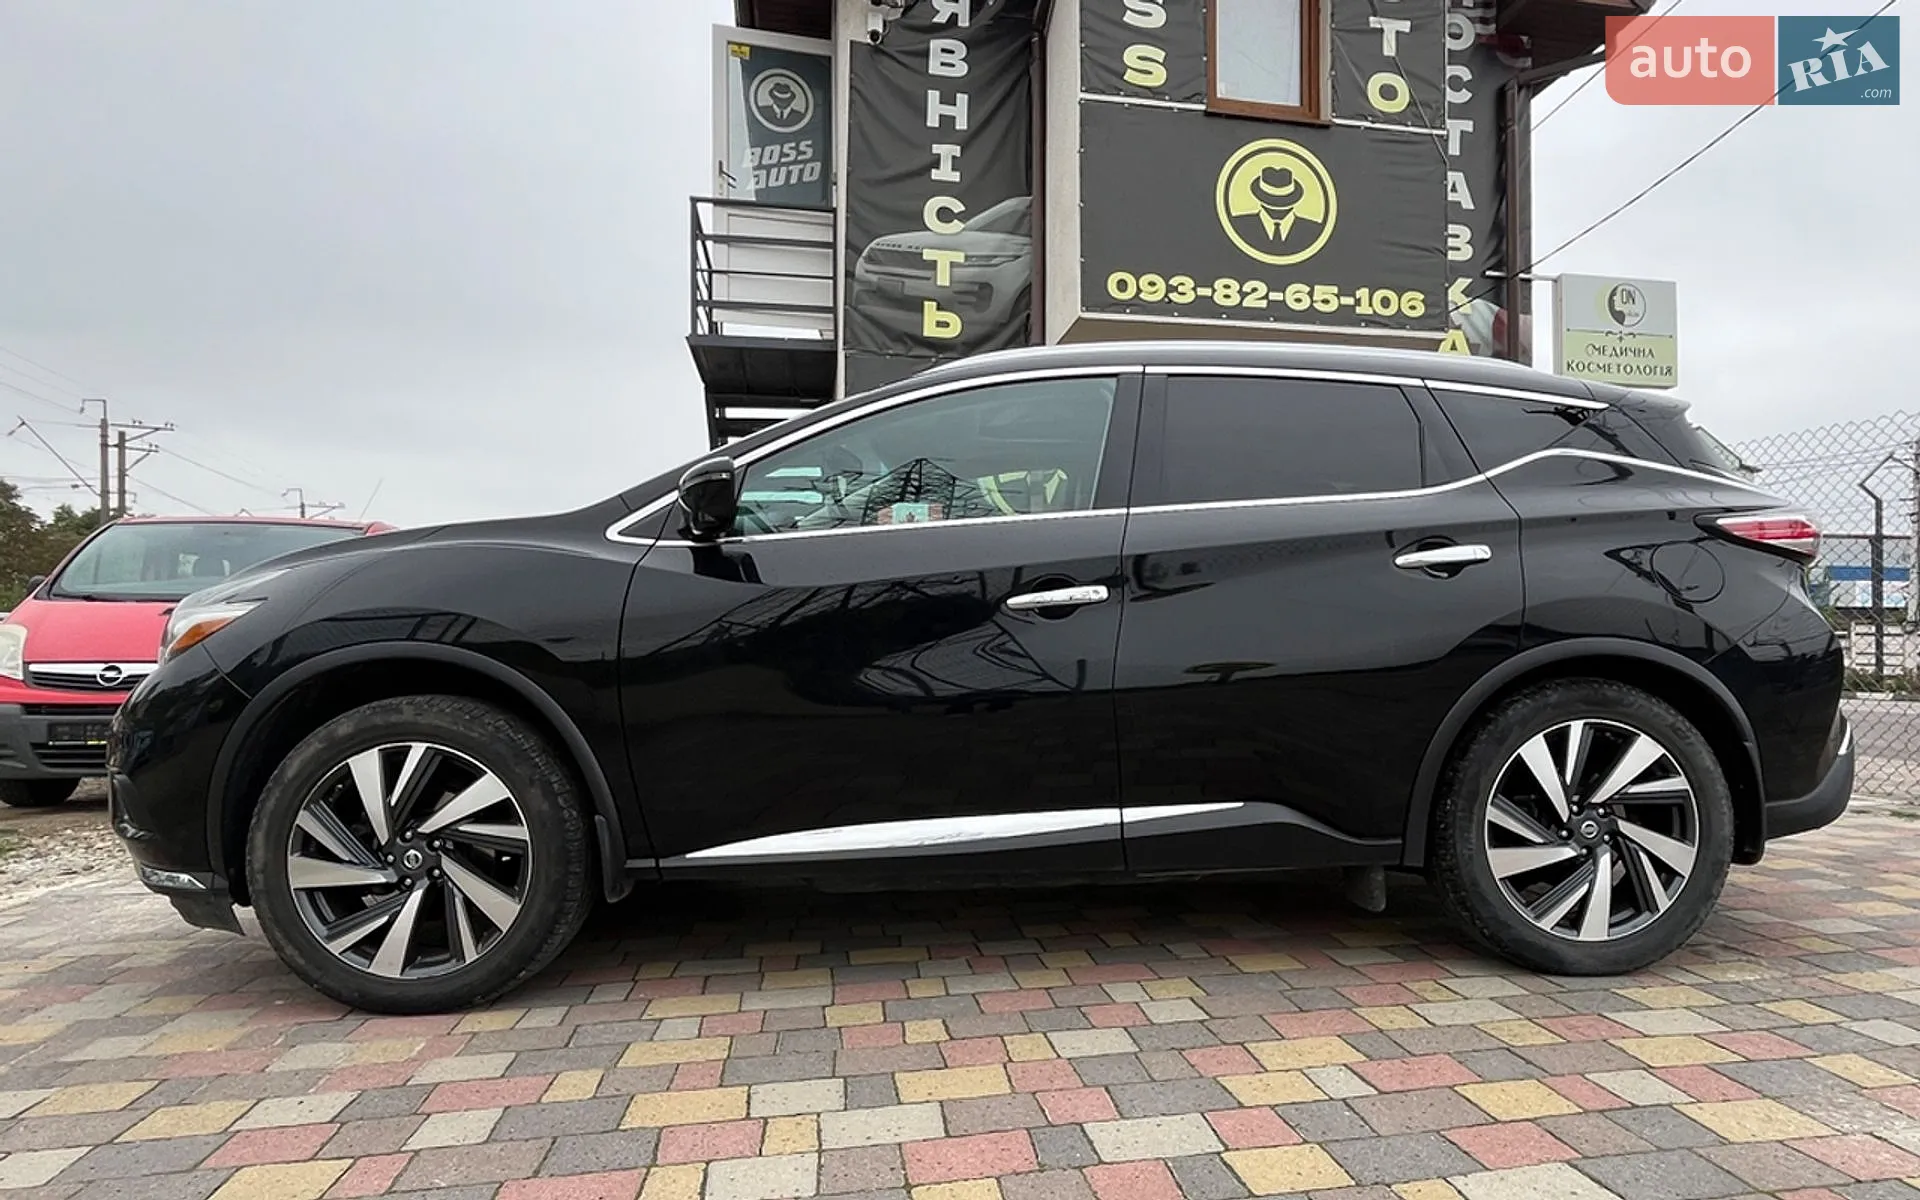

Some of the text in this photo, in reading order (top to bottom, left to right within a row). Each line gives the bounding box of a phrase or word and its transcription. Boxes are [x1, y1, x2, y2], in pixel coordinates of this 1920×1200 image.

[1367, 0, 1411, 114] TO
[742, 140, 813, 168] BOSS
[746, 162, 822, 191] AUTO
[1438, 0, 1475, 356] ОСТАВКА
[1106, 271, 1426, 318] 093-82-65-106
[1566, 359, 1673, 377] КОСМЕТОЛОГІЯ
